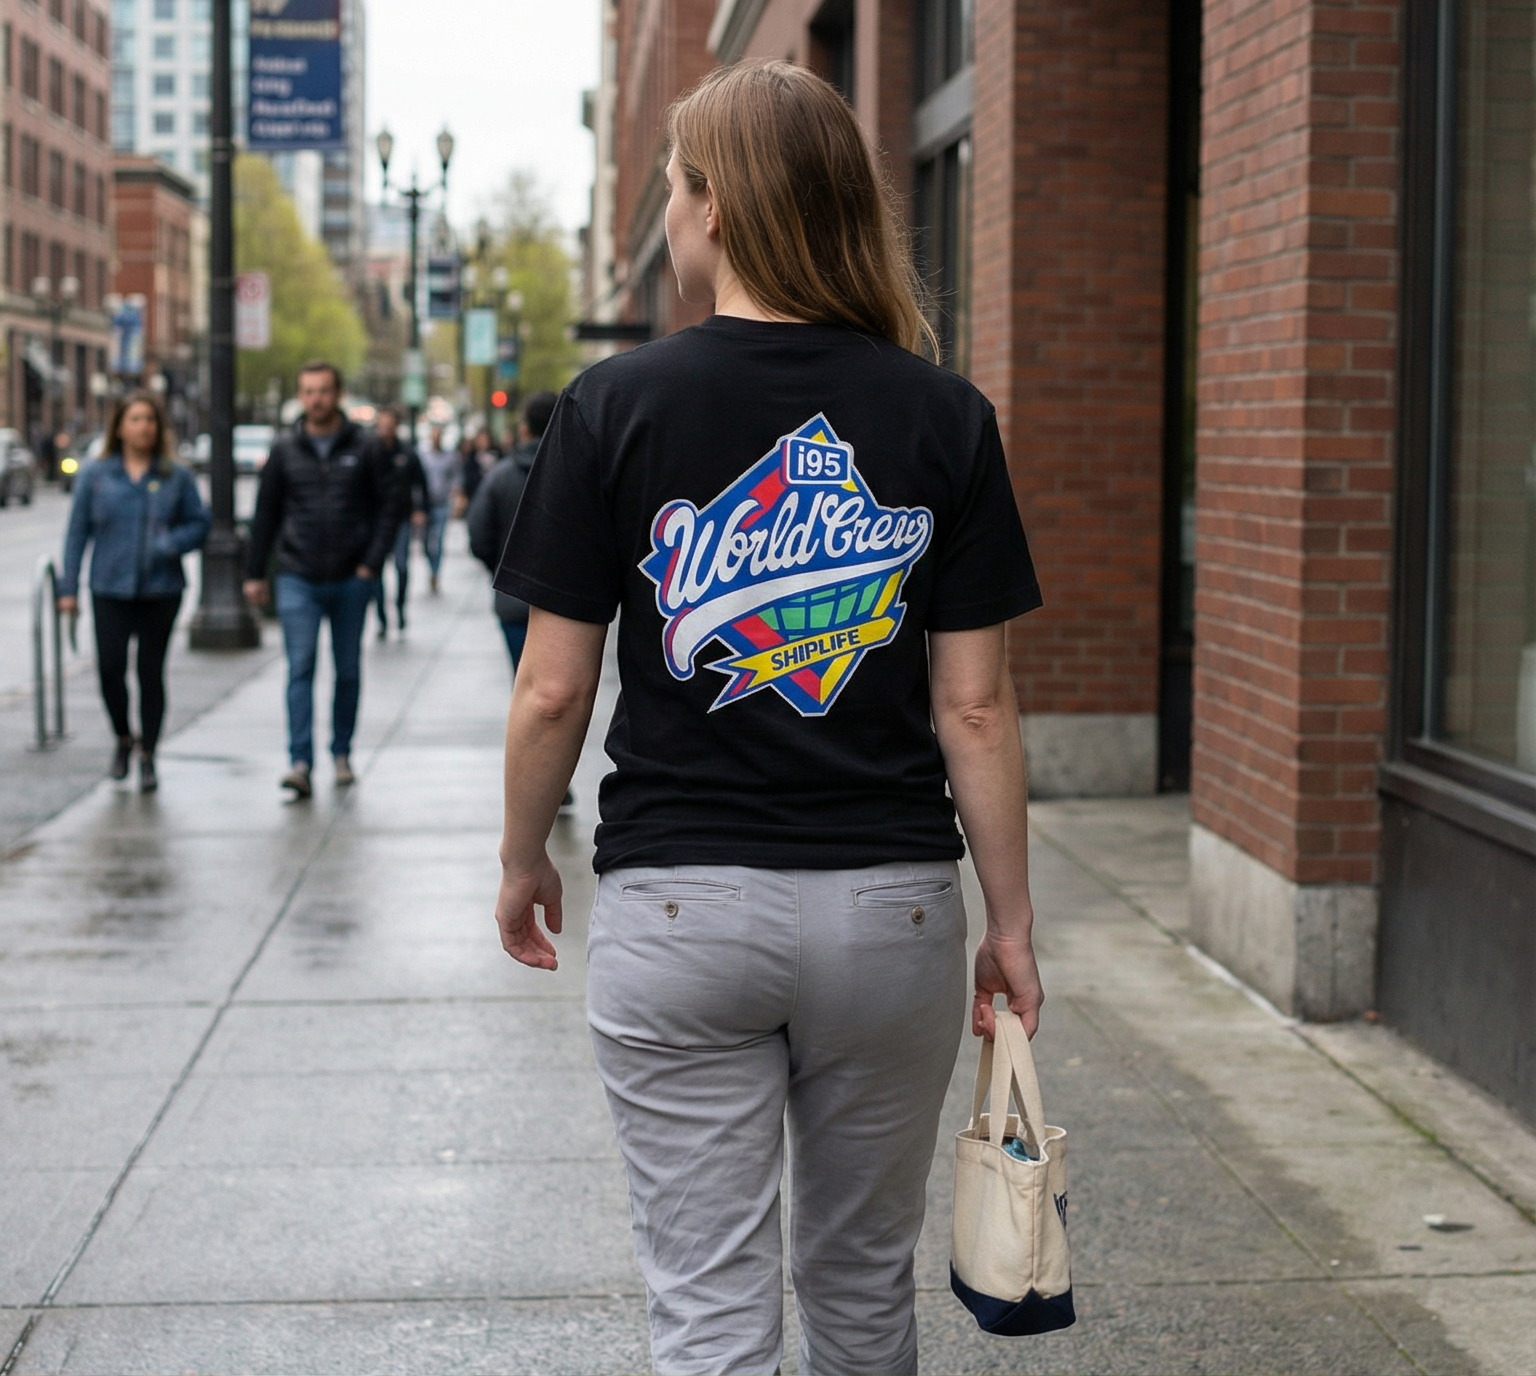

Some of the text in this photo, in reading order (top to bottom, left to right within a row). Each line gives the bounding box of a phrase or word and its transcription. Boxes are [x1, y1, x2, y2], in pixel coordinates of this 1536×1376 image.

[797, 446, 841, 477] i95
[663, 491, 930, 610] World Crew
[771, 628, 861, 672] SHIPLIFE
